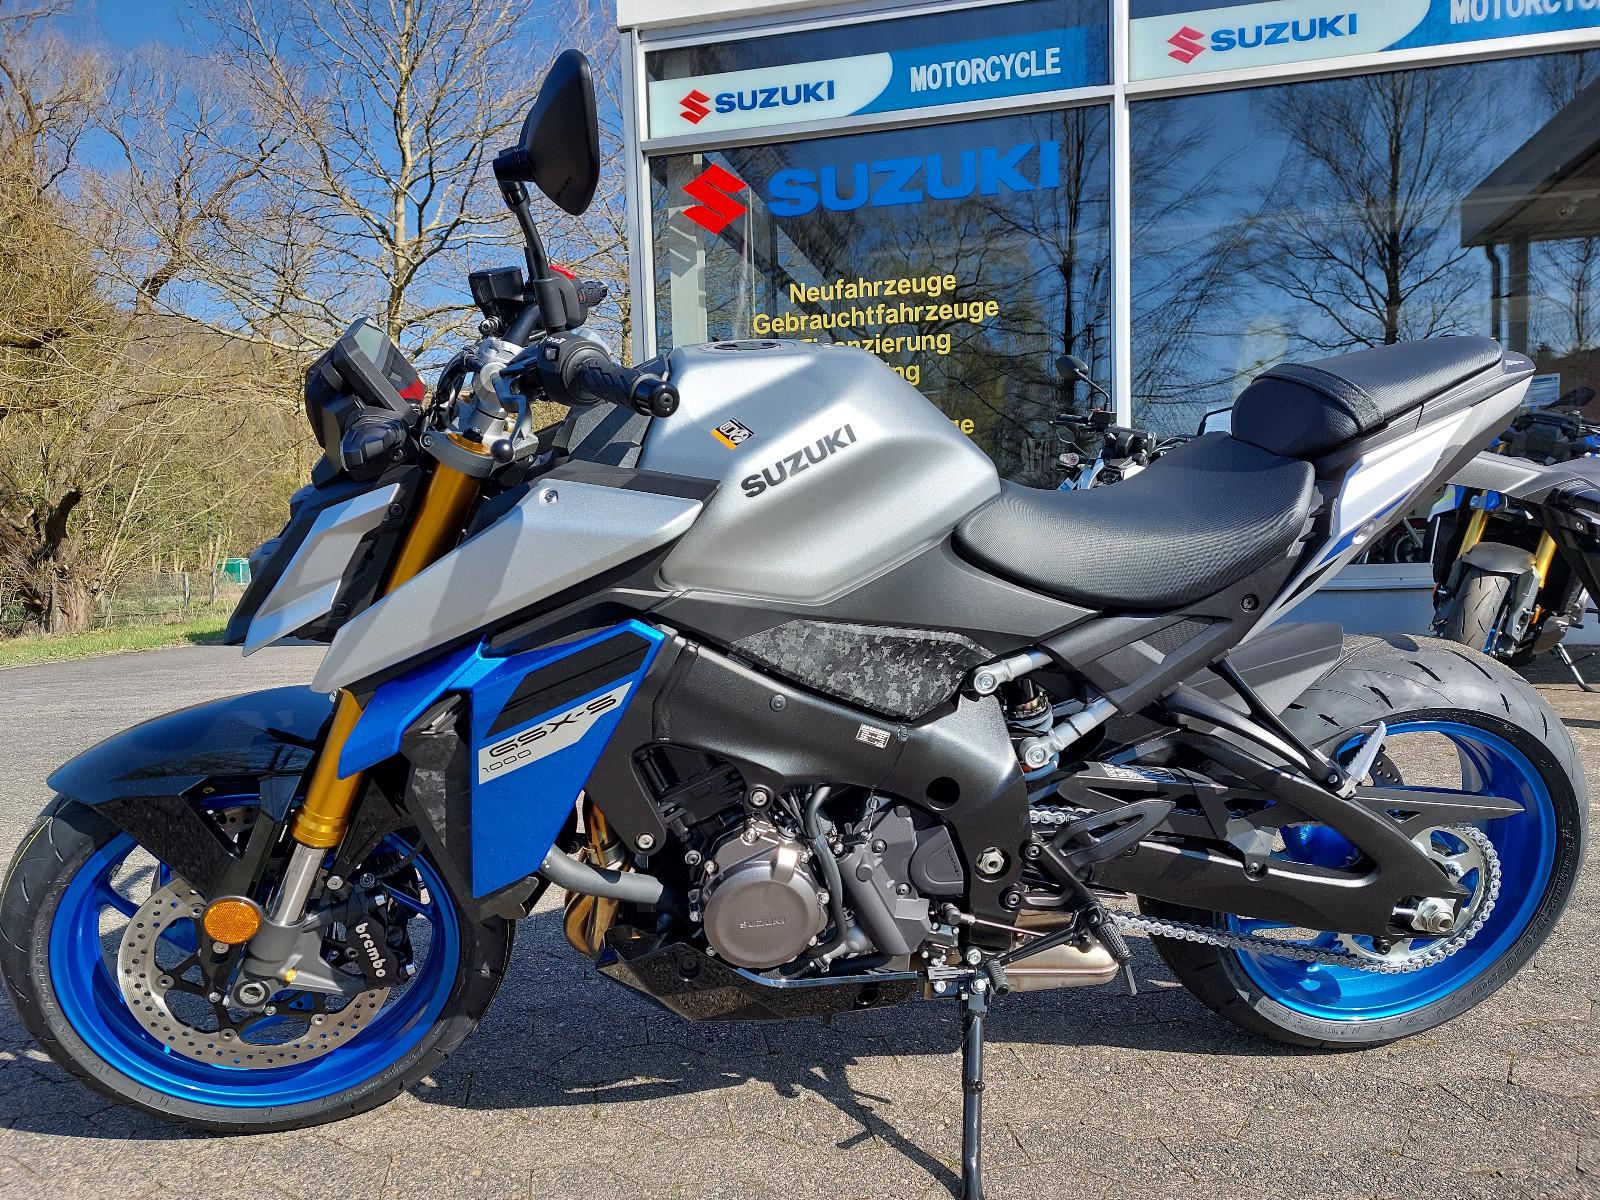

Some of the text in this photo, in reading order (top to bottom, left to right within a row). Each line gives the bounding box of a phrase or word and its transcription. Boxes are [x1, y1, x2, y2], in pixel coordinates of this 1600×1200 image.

[1210, 13, 1358, 53] SUZUKI
[714, 47, 1061, 114] SUZUKI MOTORCYCLE
[766, 140, 1060, 217] SUZUKI
[789, 273, 957, 304] Neufahrzeuge
[752, 299, 999, 335] Gebrauchtfahrzeuge
[740, 423, 857, 498] SUZUKI
[488, 693, 617, 758] GSX-S
[482, 749, 532, 774] 1000
[355, 922, 387, 978] brembo
